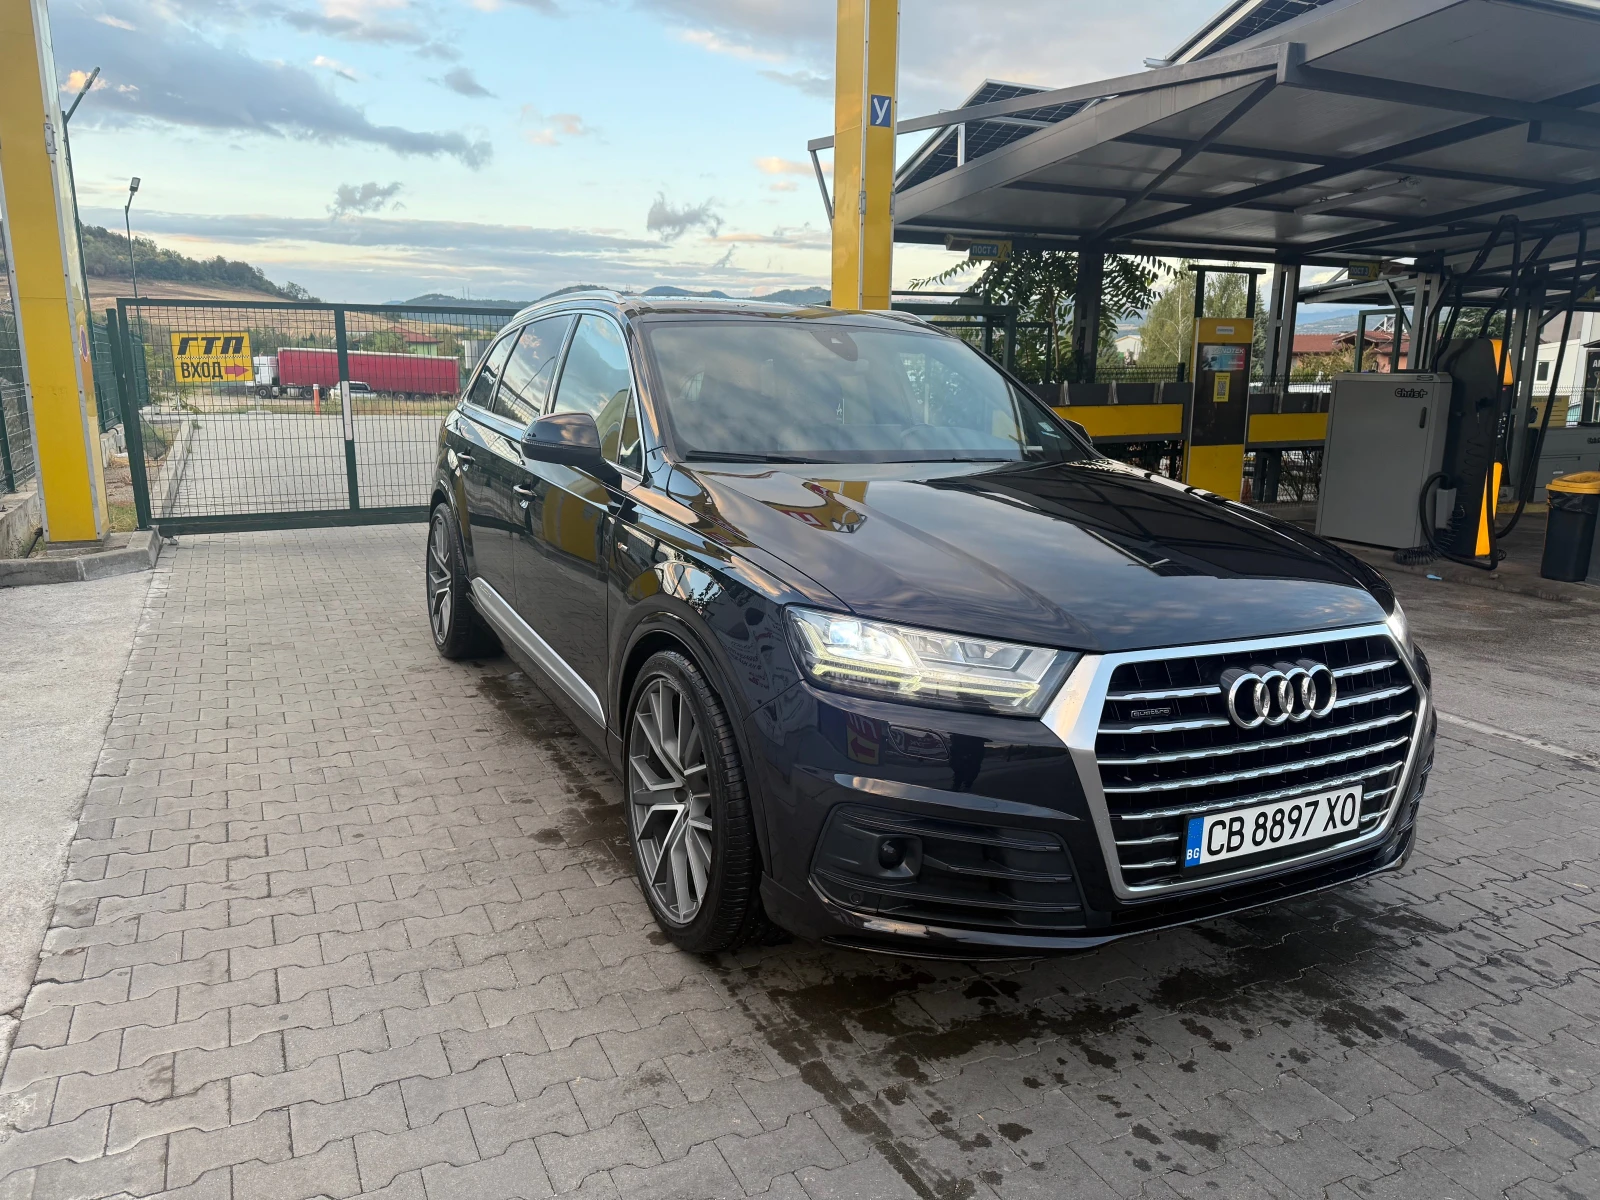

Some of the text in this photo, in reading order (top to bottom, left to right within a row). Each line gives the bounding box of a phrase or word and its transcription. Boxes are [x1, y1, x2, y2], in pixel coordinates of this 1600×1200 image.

[972, 245, 998, 255] ПОСТ 4
[177, 336, 245, 356] ГТП
[181, 361, 223, 380] ВХОД
[1394, 387, 1428, 398] Christ
[1206, 792, 1356, 856] CB 8897 XO
[1186, 847, 1200, 860] BG
